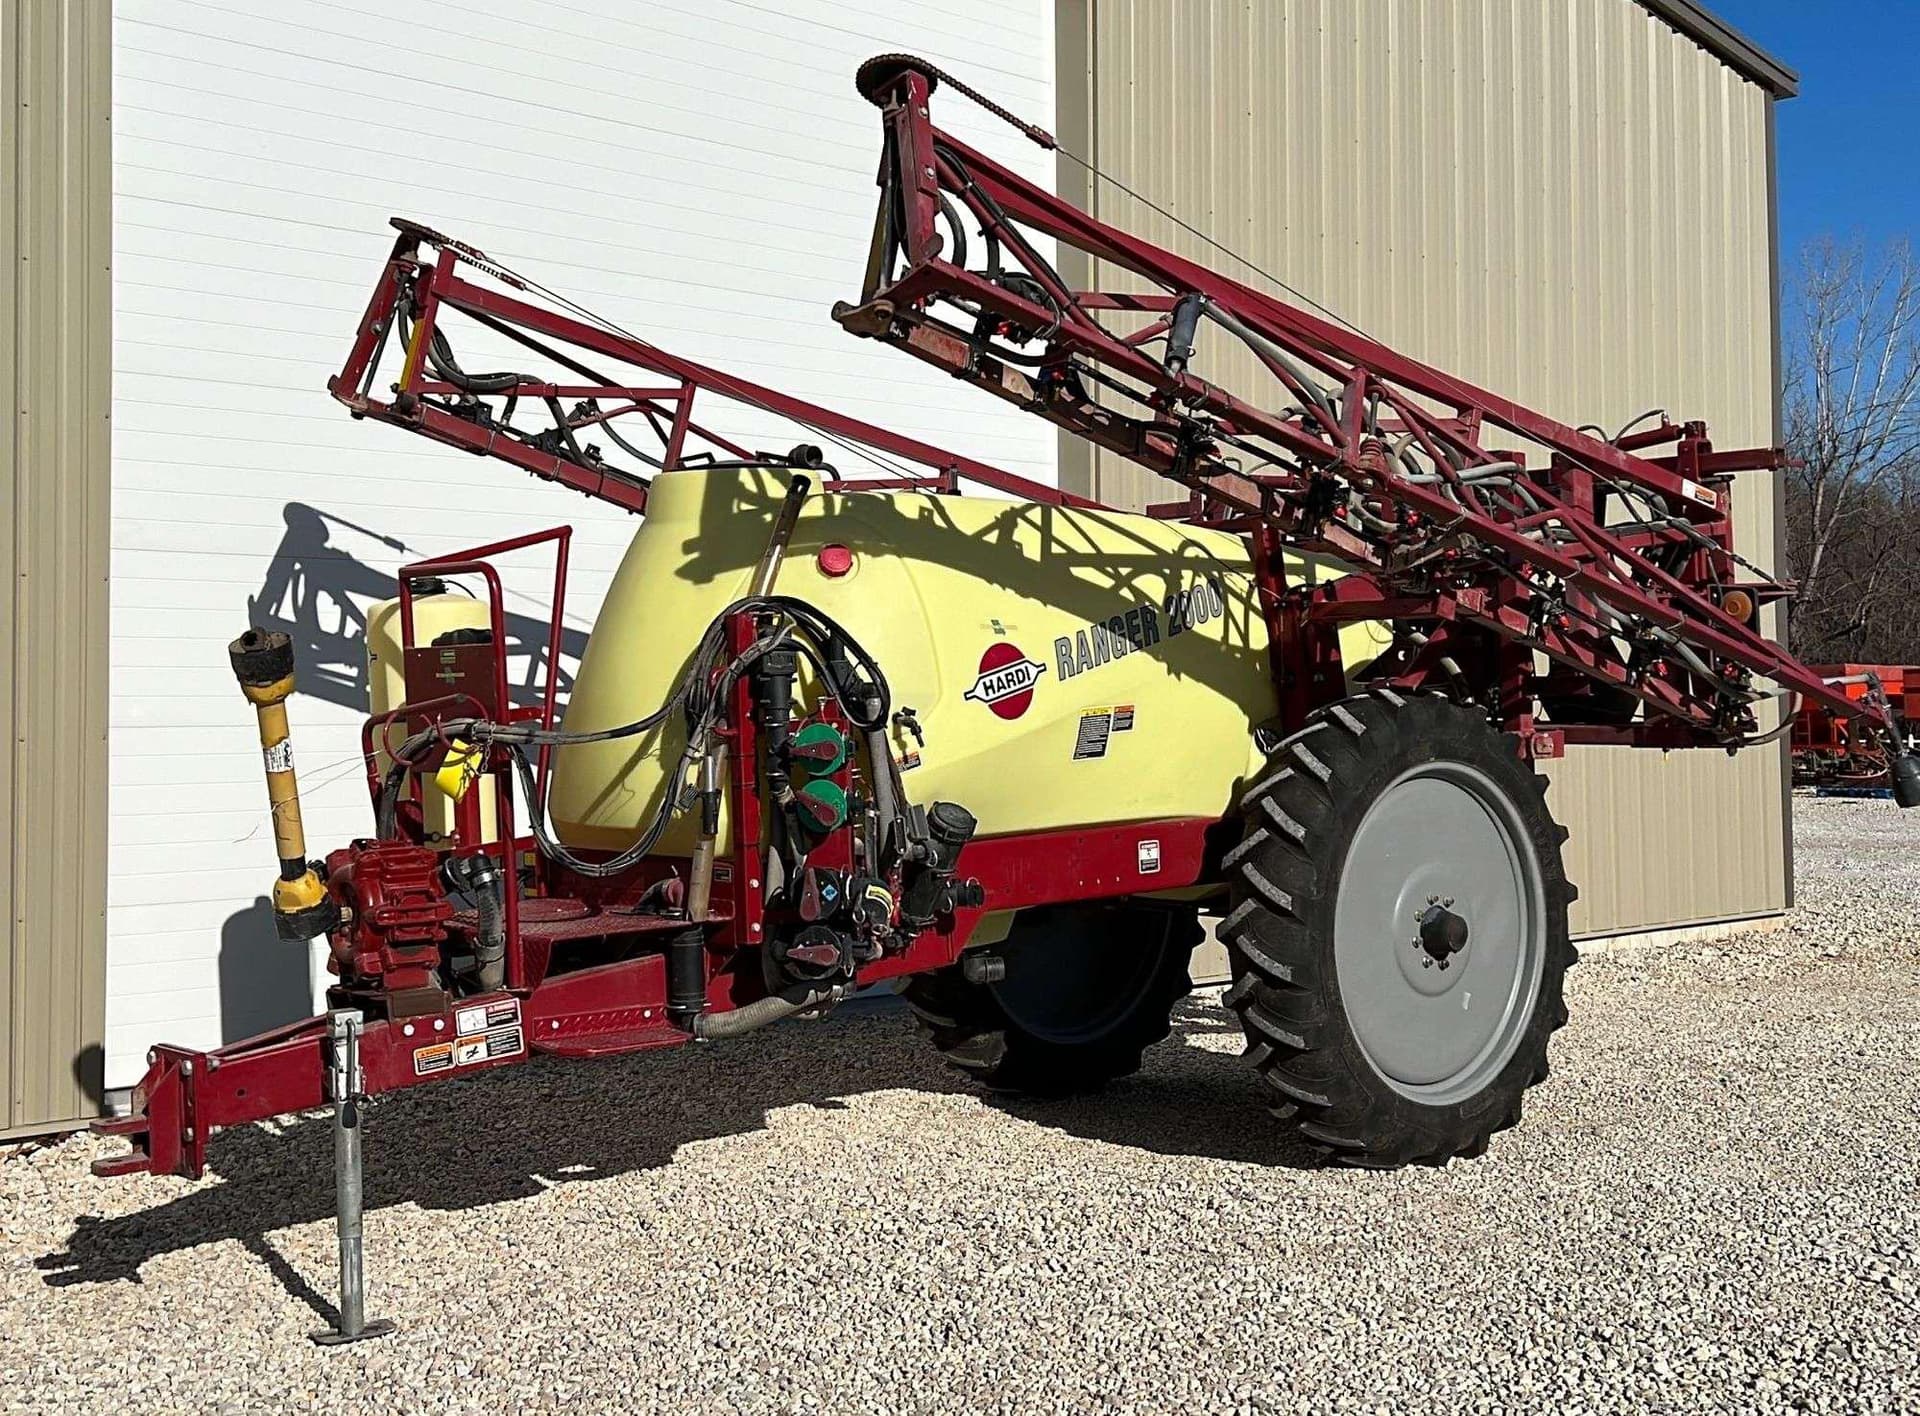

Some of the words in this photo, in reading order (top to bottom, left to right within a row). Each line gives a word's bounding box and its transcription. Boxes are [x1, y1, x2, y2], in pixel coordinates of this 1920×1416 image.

[1054, 604, 1160, 681] RANGER
[1165, 578, 1223, 636] 2000
[982, 665, 1031, 697] HARDI
